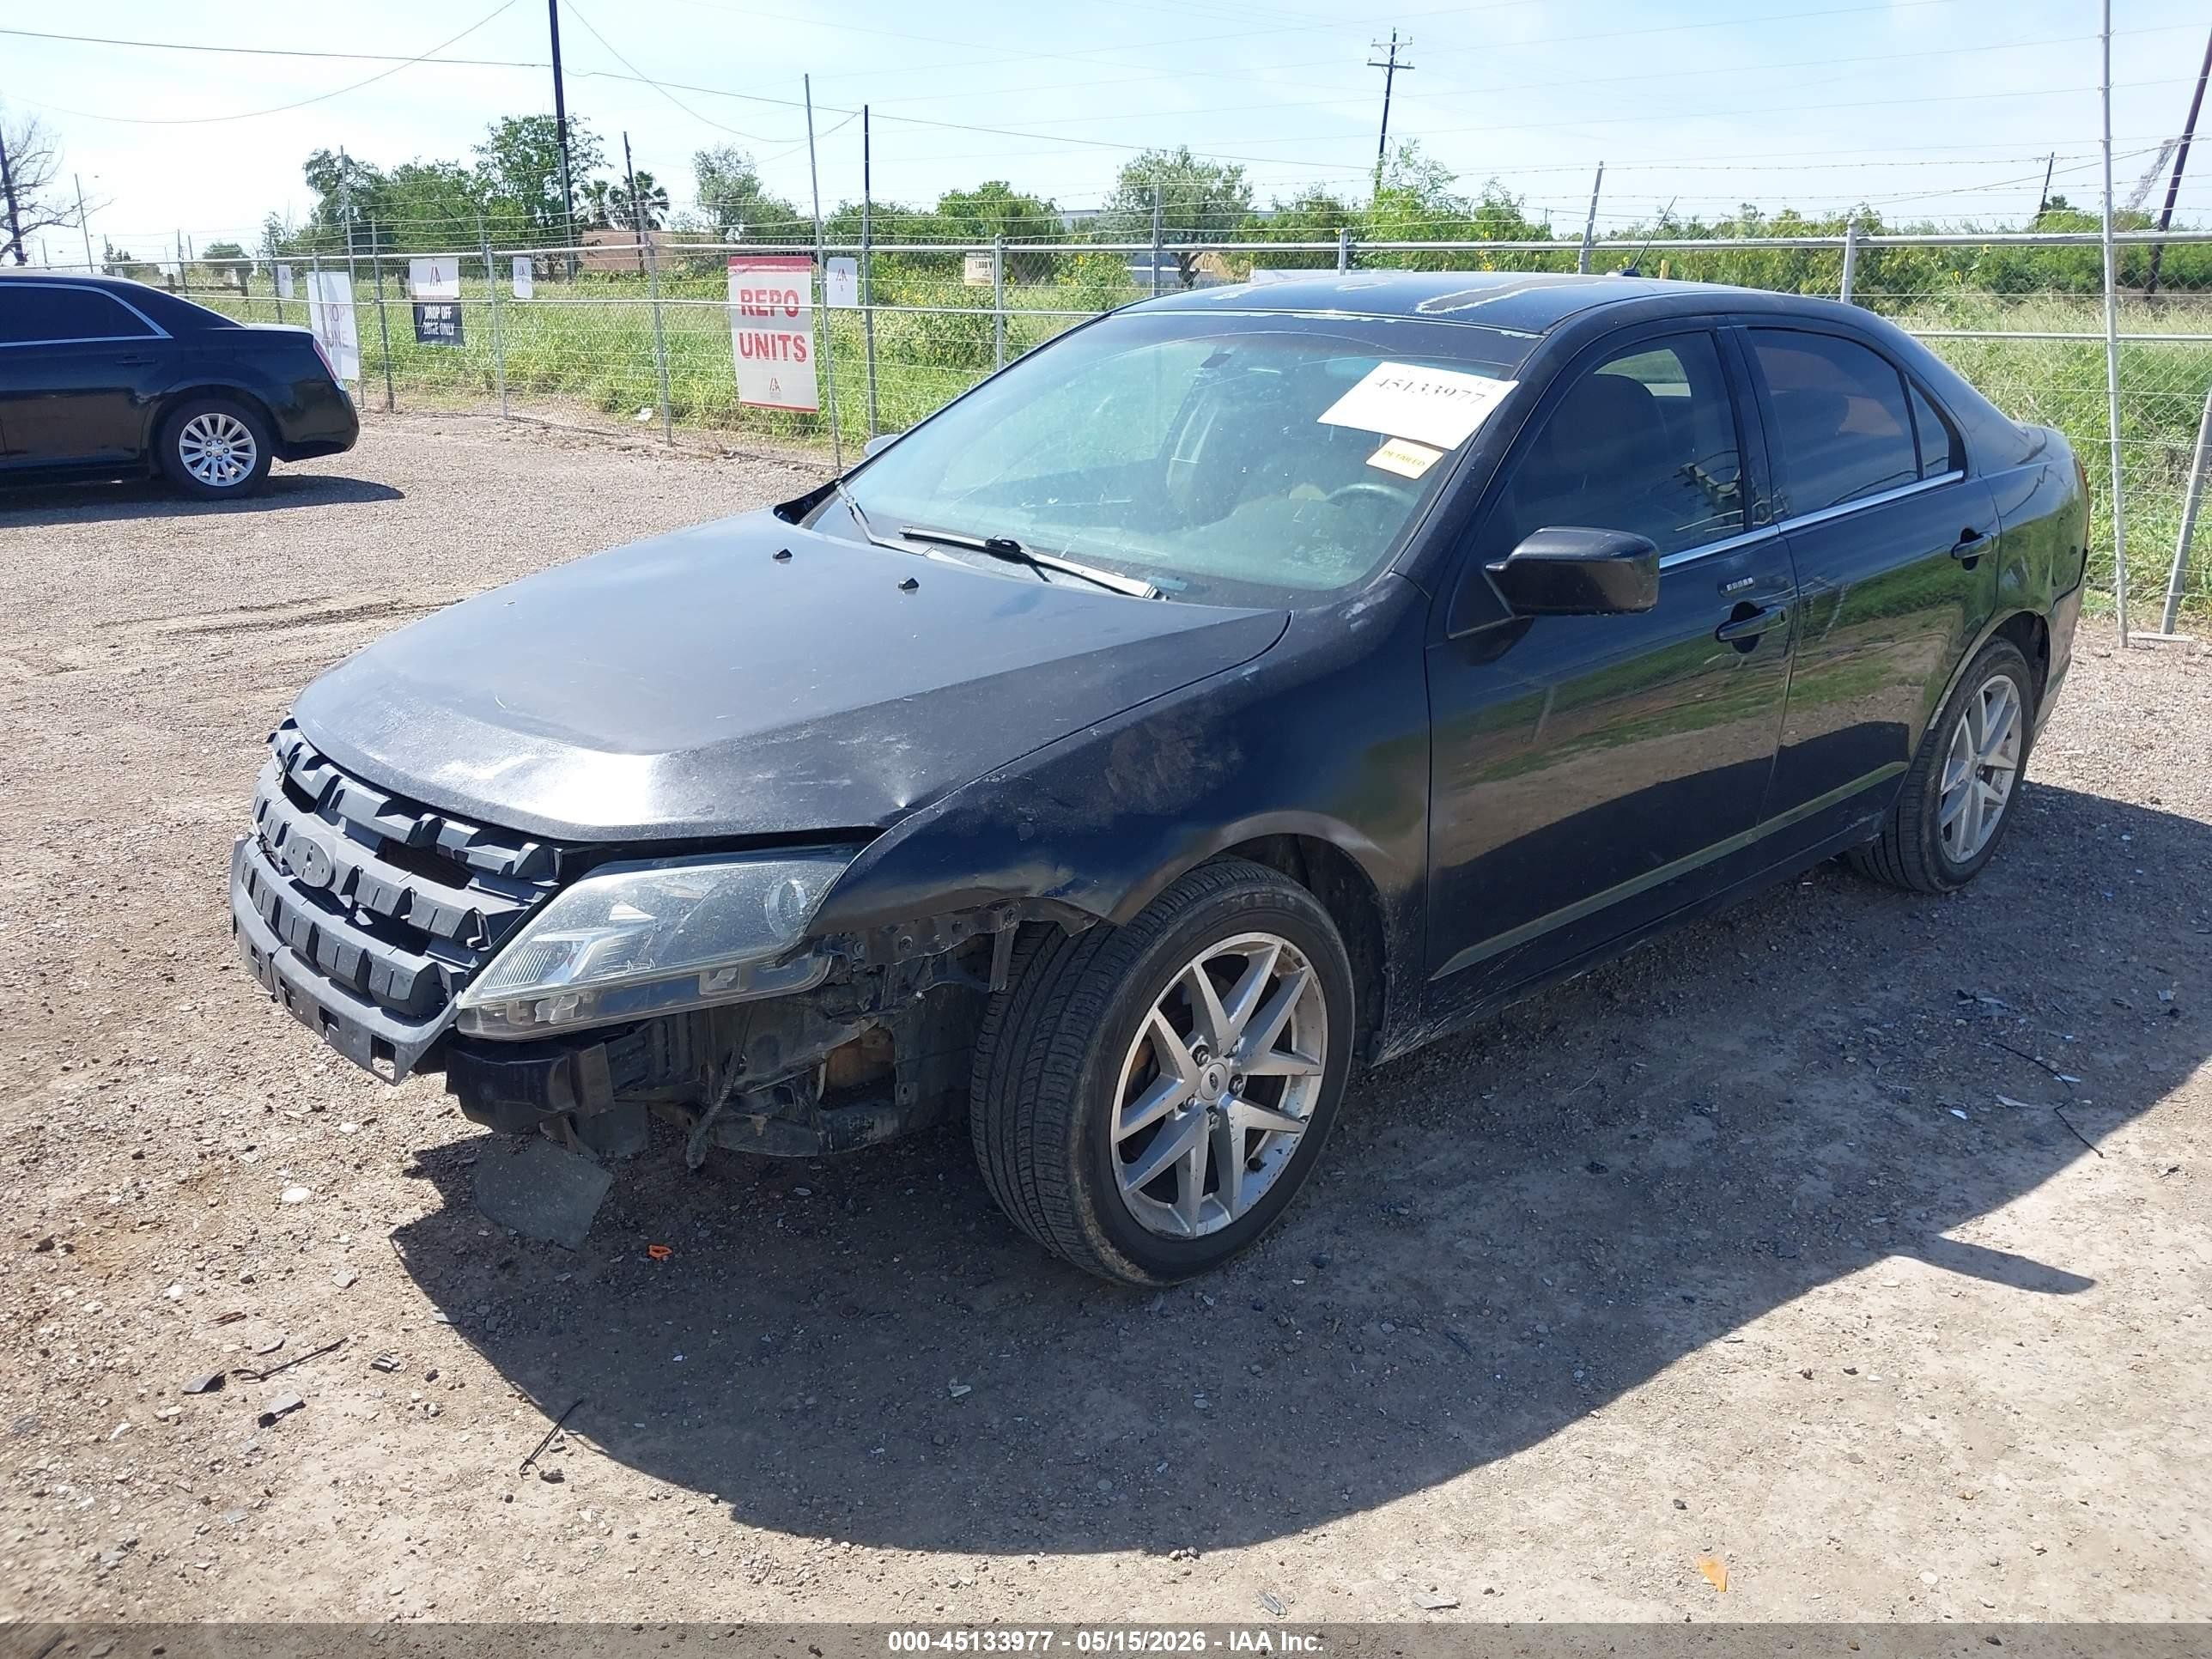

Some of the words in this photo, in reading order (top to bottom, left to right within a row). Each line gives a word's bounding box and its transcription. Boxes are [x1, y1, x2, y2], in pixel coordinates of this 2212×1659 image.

[424, 306, 440, 319] DROP
[441, 306, 452, 320] OFF
[740, 289, 799, 318] REPO
[423, 321, 439, 335] ZONE
[439, 322, 454, 336] ONLY
[739, 332, 807, 362] UNITS
